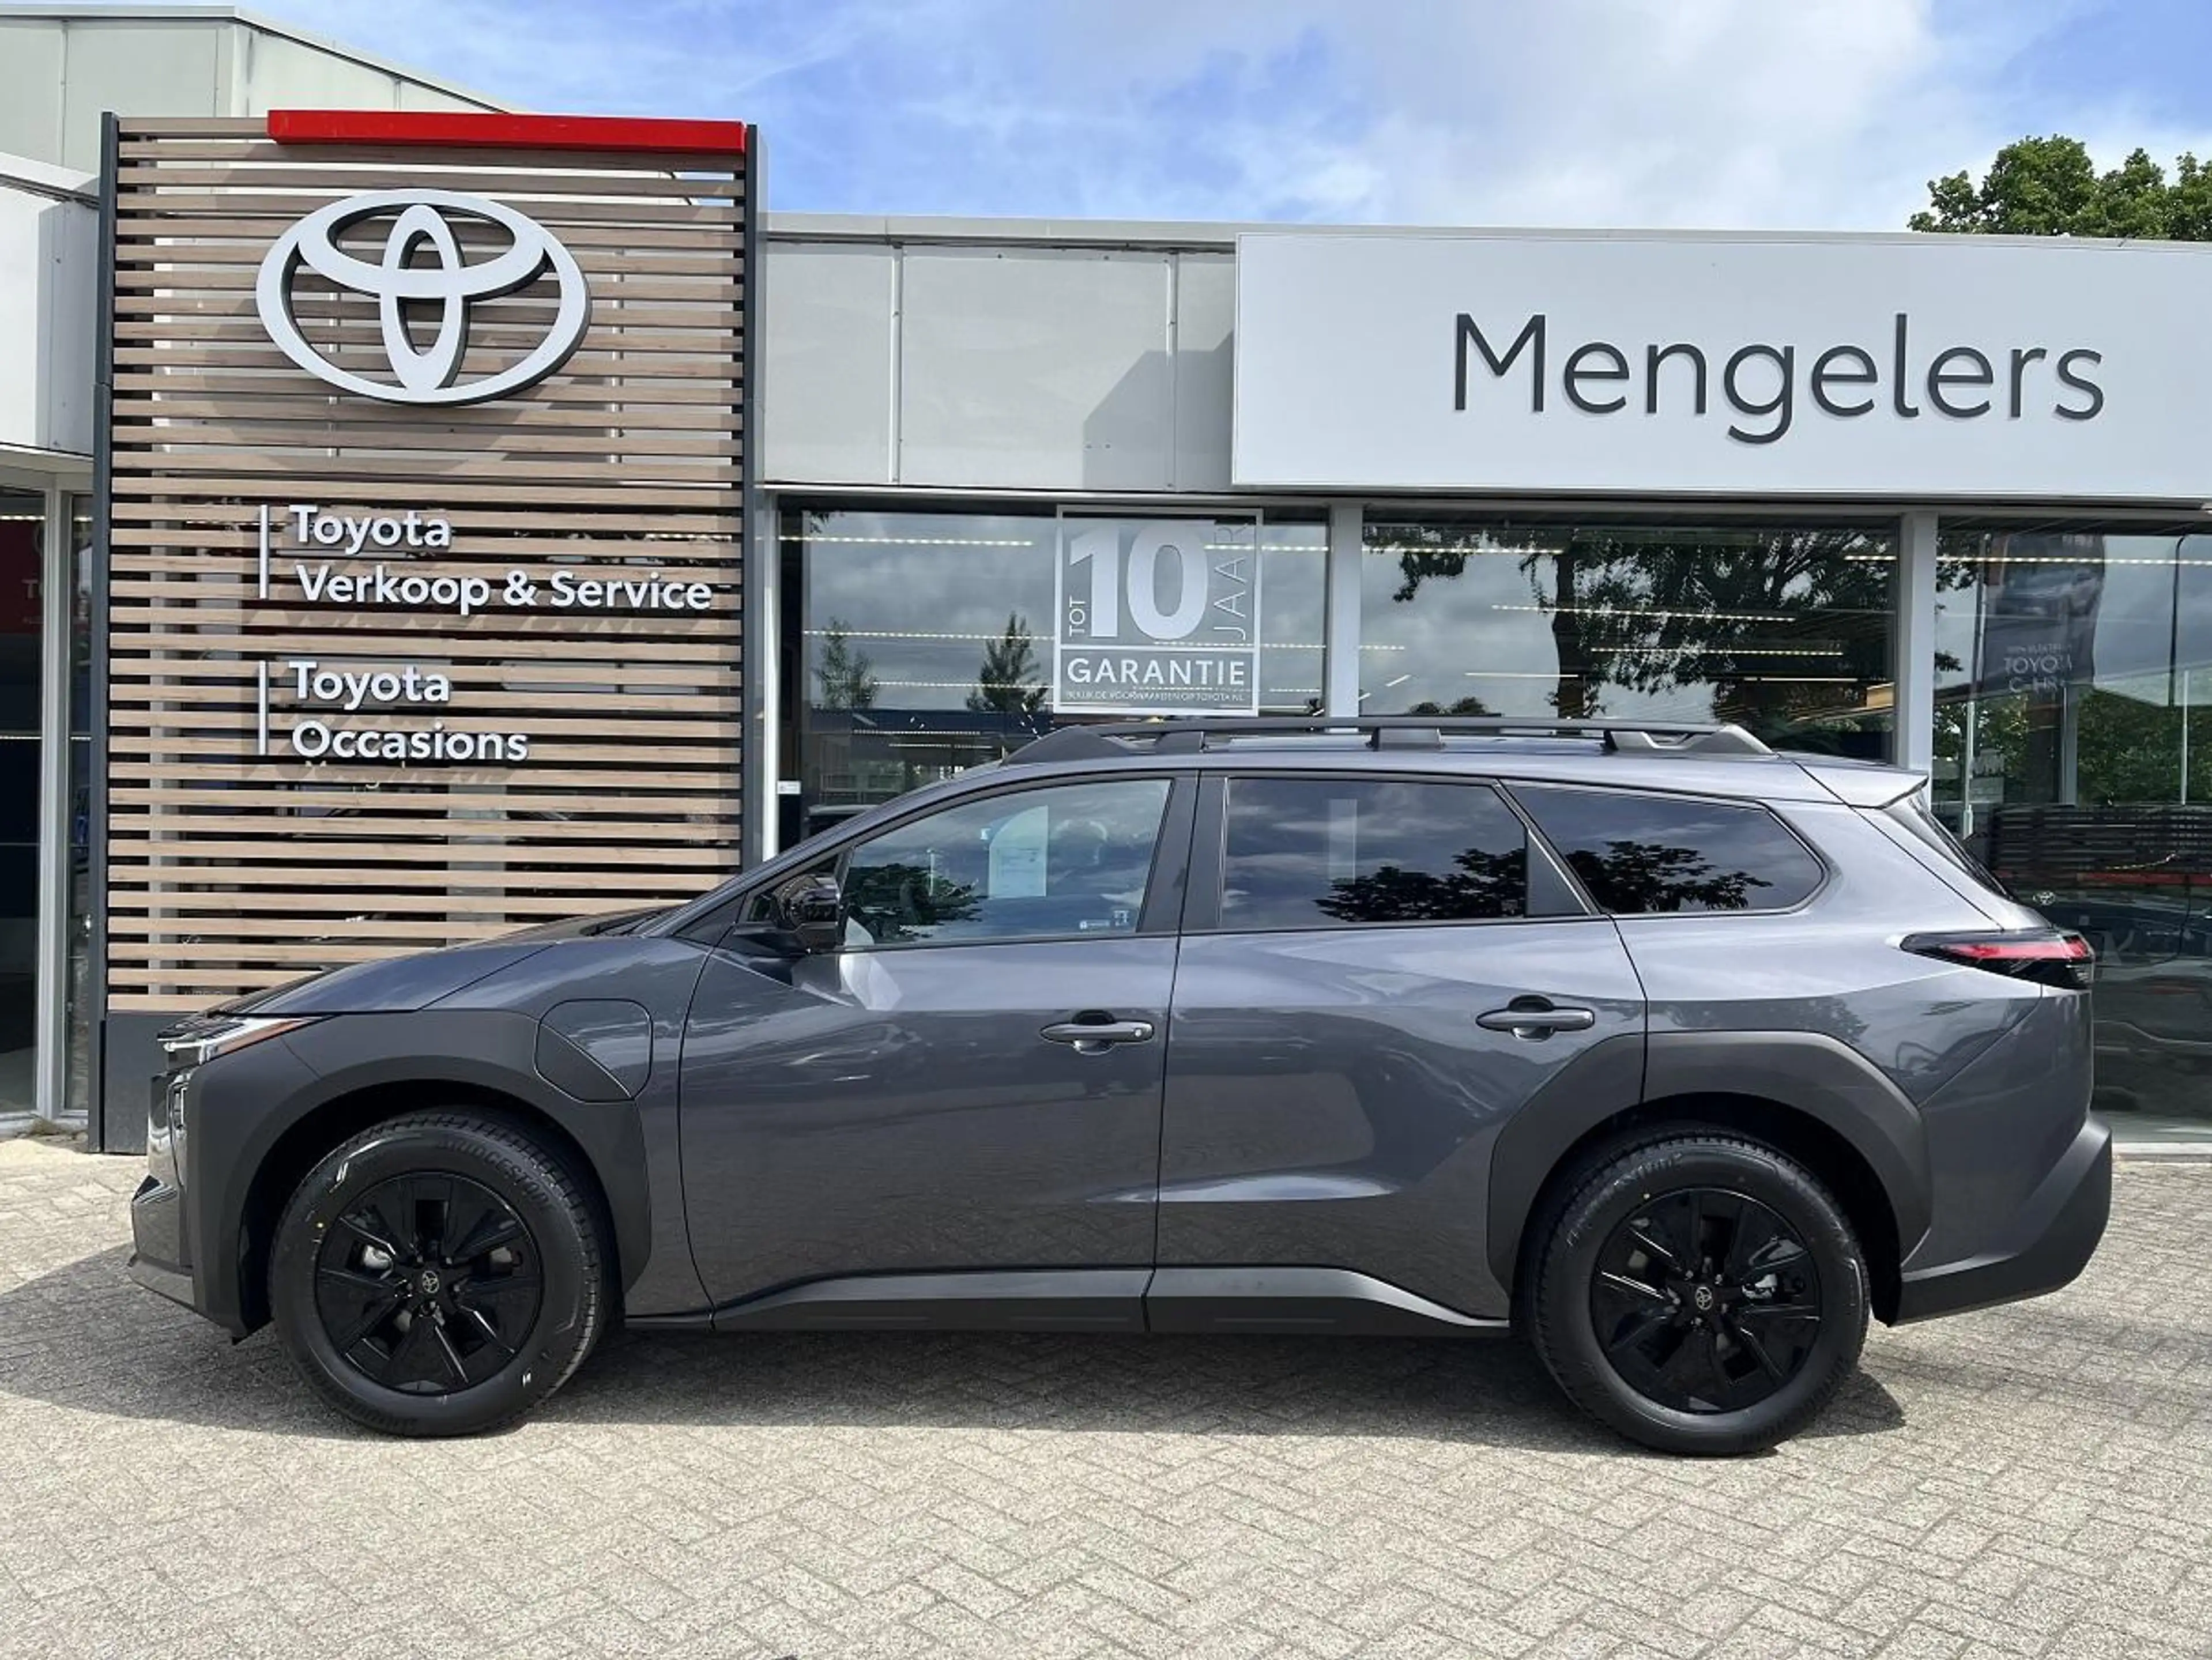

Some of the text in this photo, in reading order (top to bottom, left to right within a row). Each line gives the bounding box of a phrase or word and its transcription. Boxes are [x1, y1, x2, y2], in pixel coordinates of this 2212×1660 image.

[1454, 312, 2105, 444] Mengelers
[289, 504, 452, 554] Toyota
[296, 564, 713, 615] Verkoop & Service
[1069, 522, 1209, 640] 10
[1213, 523, 1250, 640] JAAR
[1069, 595, 1086, 637] TOT
[289, 661, 451, 710] Toyota
[1067, 657, 1245, 686] GARANTIE
[292, 720, 528, 762] Occasions
